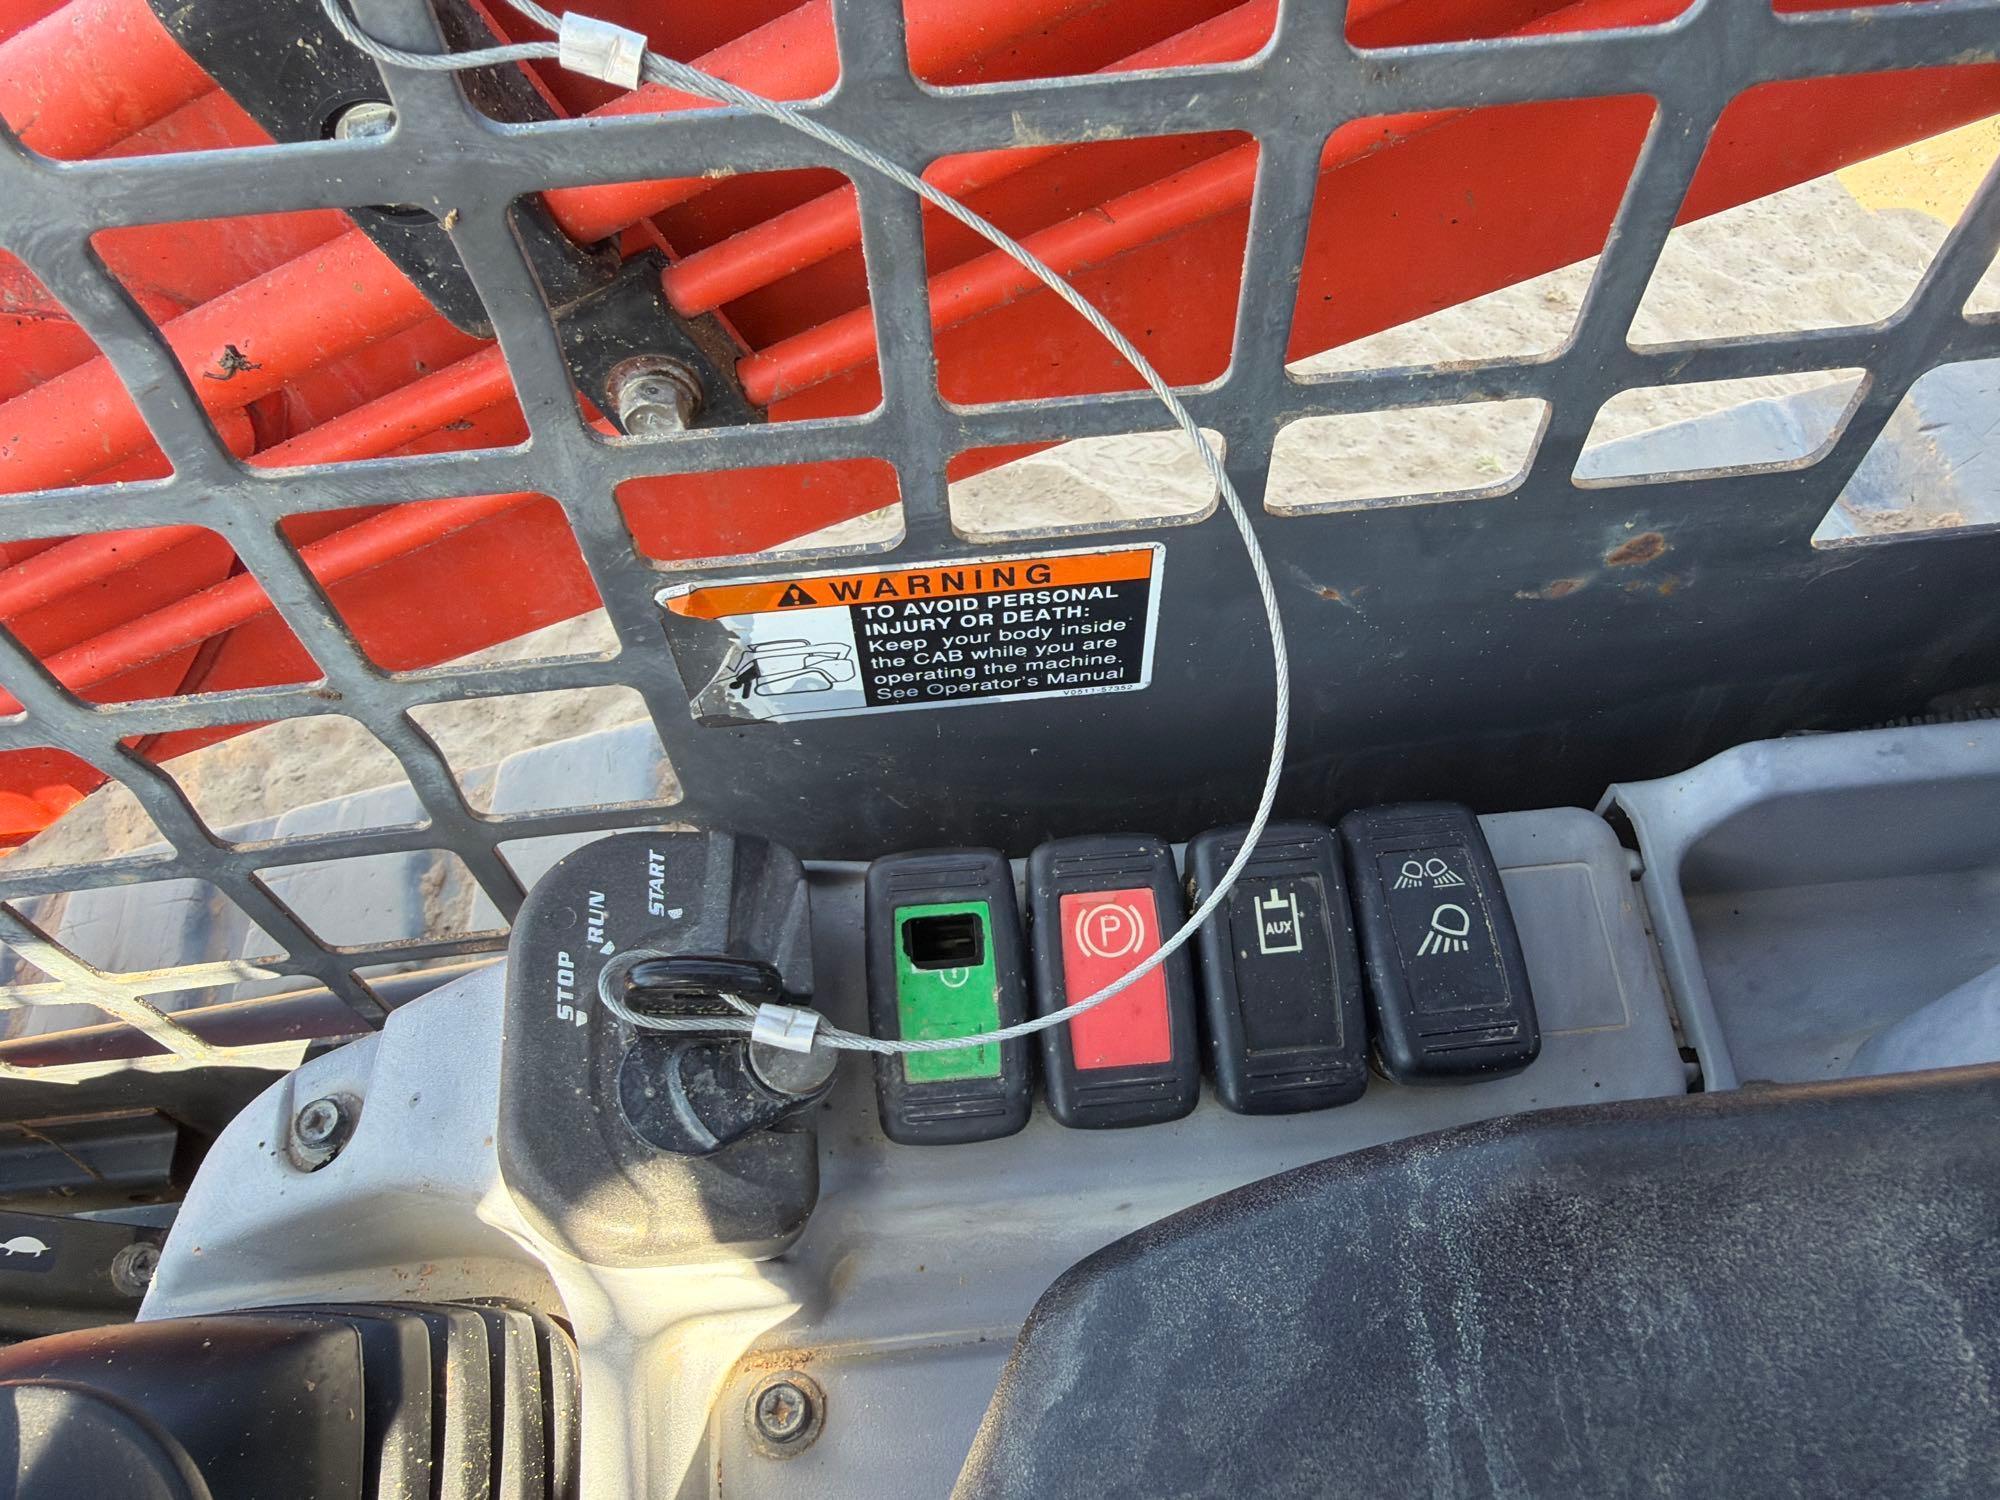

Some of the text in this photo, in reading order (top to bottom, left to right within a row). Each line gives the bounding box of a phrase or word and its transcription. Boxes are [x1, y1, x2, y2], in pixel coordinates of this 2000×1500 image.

[829, 563, 1051, 601] WARNING
[861, 586, 1119, 620] TO AVOID PERSONAL
[865, 605, 1090, 636] INJURY OR DEATH:
[868, 619, 1126, 653] Keep your body inside
[870, 638, 1118, 669] the CAB while you are
[874, 655, 1122, 686] operating the machine.
[877, 667, 1124, 700] See Operator's Manual
[648, 849, 666, 917] START
[587, 890, 605, 944] RUN
[1099, 915, 1121, 946] P
[1265, 920, 1292, 935] AUX
[557, 951, 575, 1021] STOP
